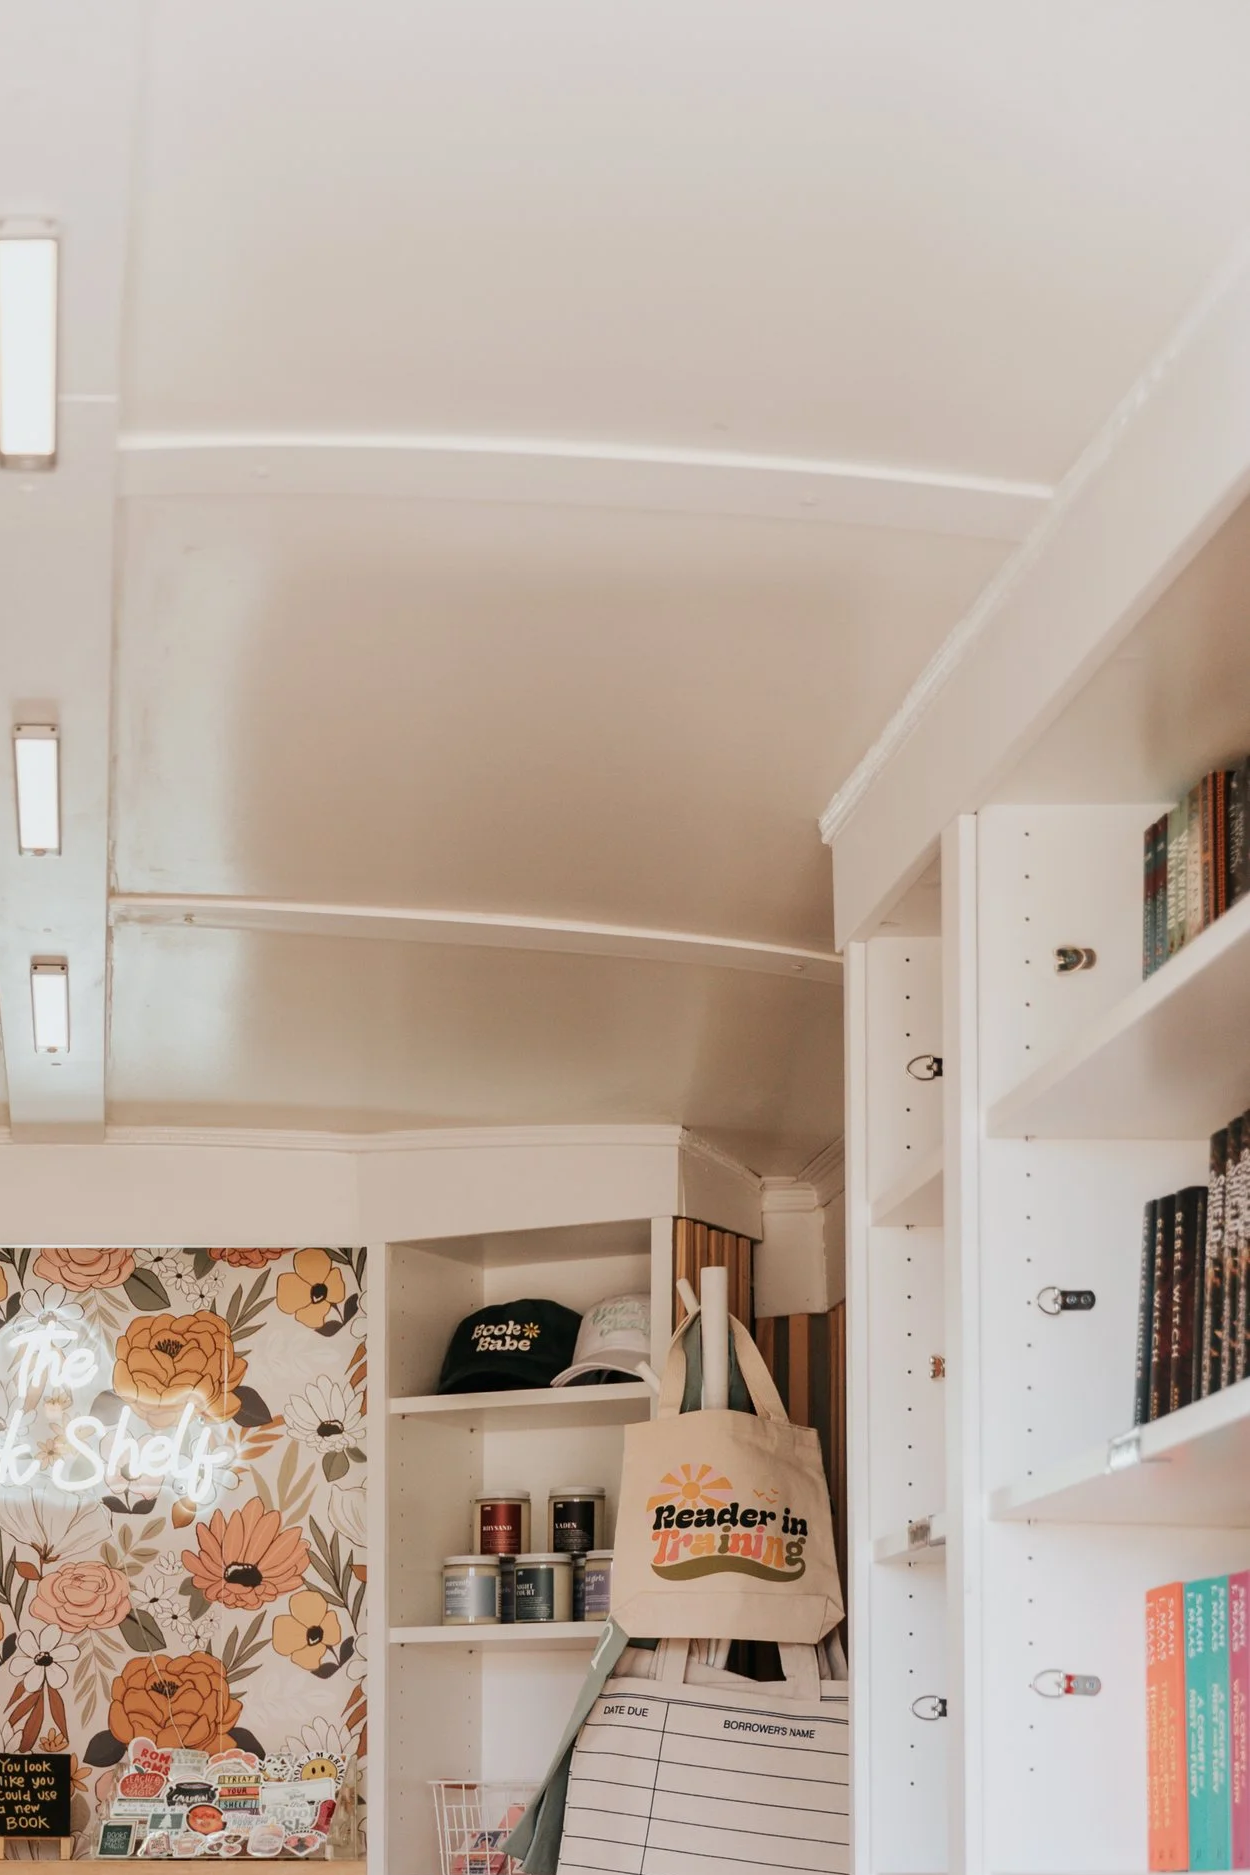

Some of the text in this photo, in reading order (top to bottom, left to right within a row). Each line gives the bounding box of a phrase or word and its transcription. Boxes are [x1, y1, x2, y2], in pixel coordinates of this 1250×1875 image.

[1171, 1212, 1183, 1357] REBEL WITCH
[471, 1321, 521, 1339] Book
[477, 1338, 531, 1351] Babe
[8, 1320, 98, 1398] The
[52, 1402, 228, 1501] Shelf
[652, 1502, 808, 1536] Reader in
[652, 1525, 807, 1568] Training
[603, 1705, 815, 1739] DATE DUE BORROWER'S NAME
[141, 1748, 171, 1763] ROM
[25, 1760, 52, 1773] look
[0, 1776, 54, 1789] like you
[37, 1791, 57, 1800] use
[228, 1787, 248, 1795] YOUR
[14, 1804, 40, 1814] new
[224, 1801, 248, 1809] SHELF
[6, 1816, 50, 1830] BOOK
